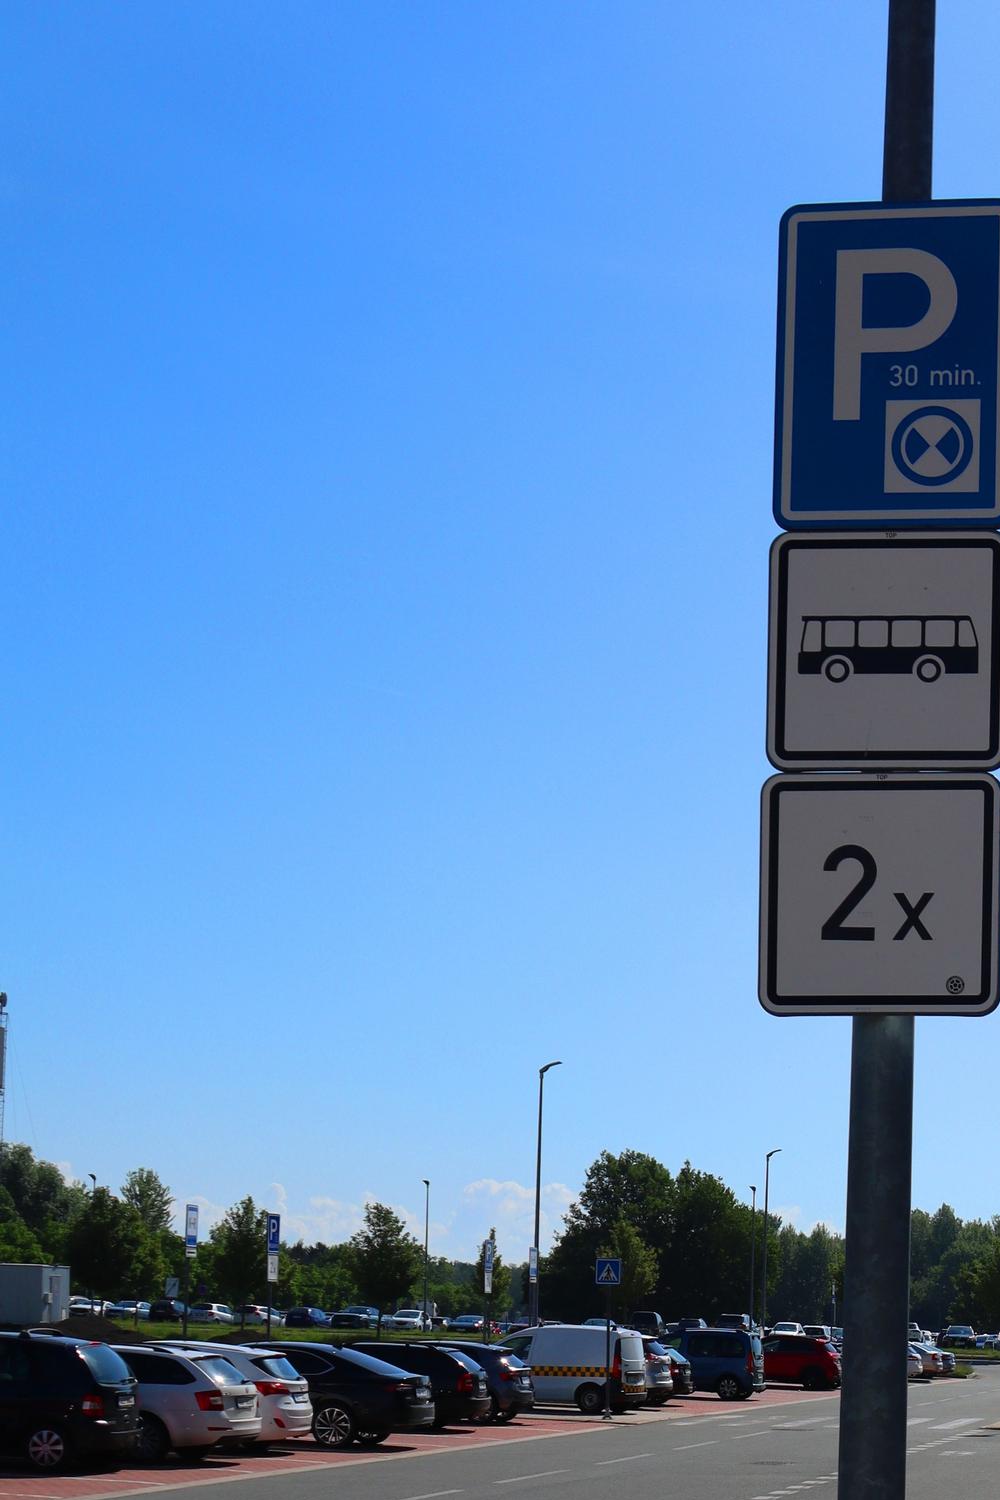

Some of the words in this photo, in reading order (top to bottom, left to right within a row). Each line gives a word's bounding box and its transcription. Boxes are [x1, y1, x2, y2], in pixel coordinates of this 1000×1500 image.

[833, 247, 958, 421] P
[889, 365, 918, 387] 30
[929, 364, 982, 386] min.
[270, 1219, 278, 1241] P
